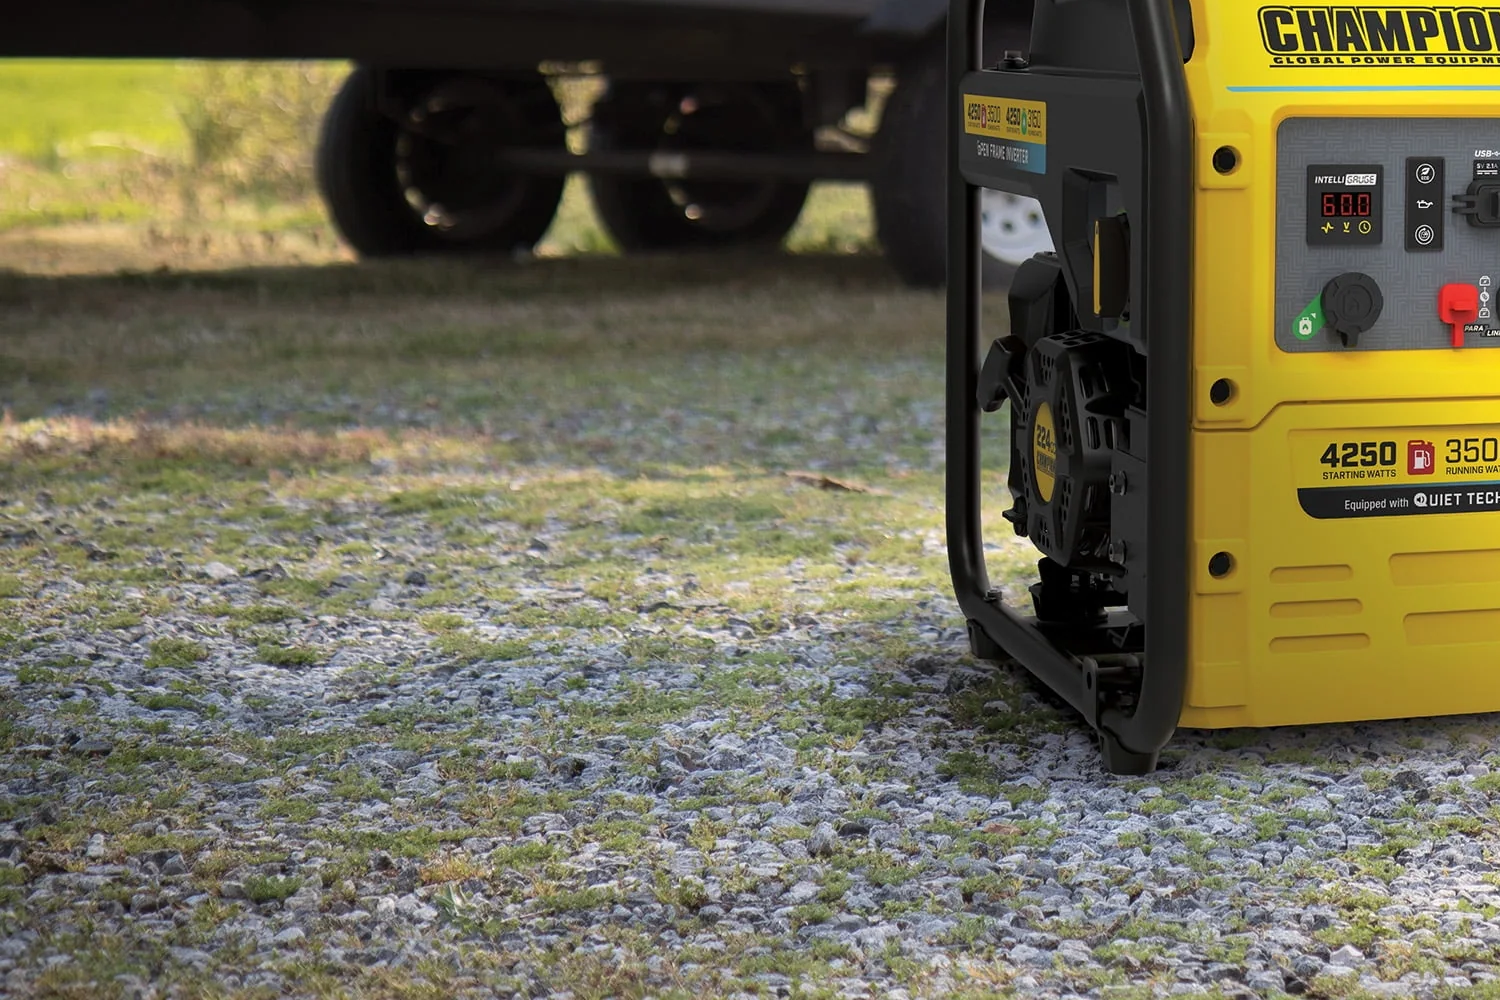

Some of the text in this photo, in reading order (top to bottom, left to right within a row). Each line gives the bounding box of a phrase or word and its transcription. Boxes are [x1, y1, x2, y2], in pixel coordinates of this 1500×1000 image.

[1320, 441, 1396, 468] 4250
[1322, 469, 1397, 480] STARTING WATTS
[1446, 465, 1483, 475] RUNNING
[1344, 499, 1386, 511] Equipped
[1389, 498, 1409, 508] with
[1413, 492, 1462, 507] QUIET
